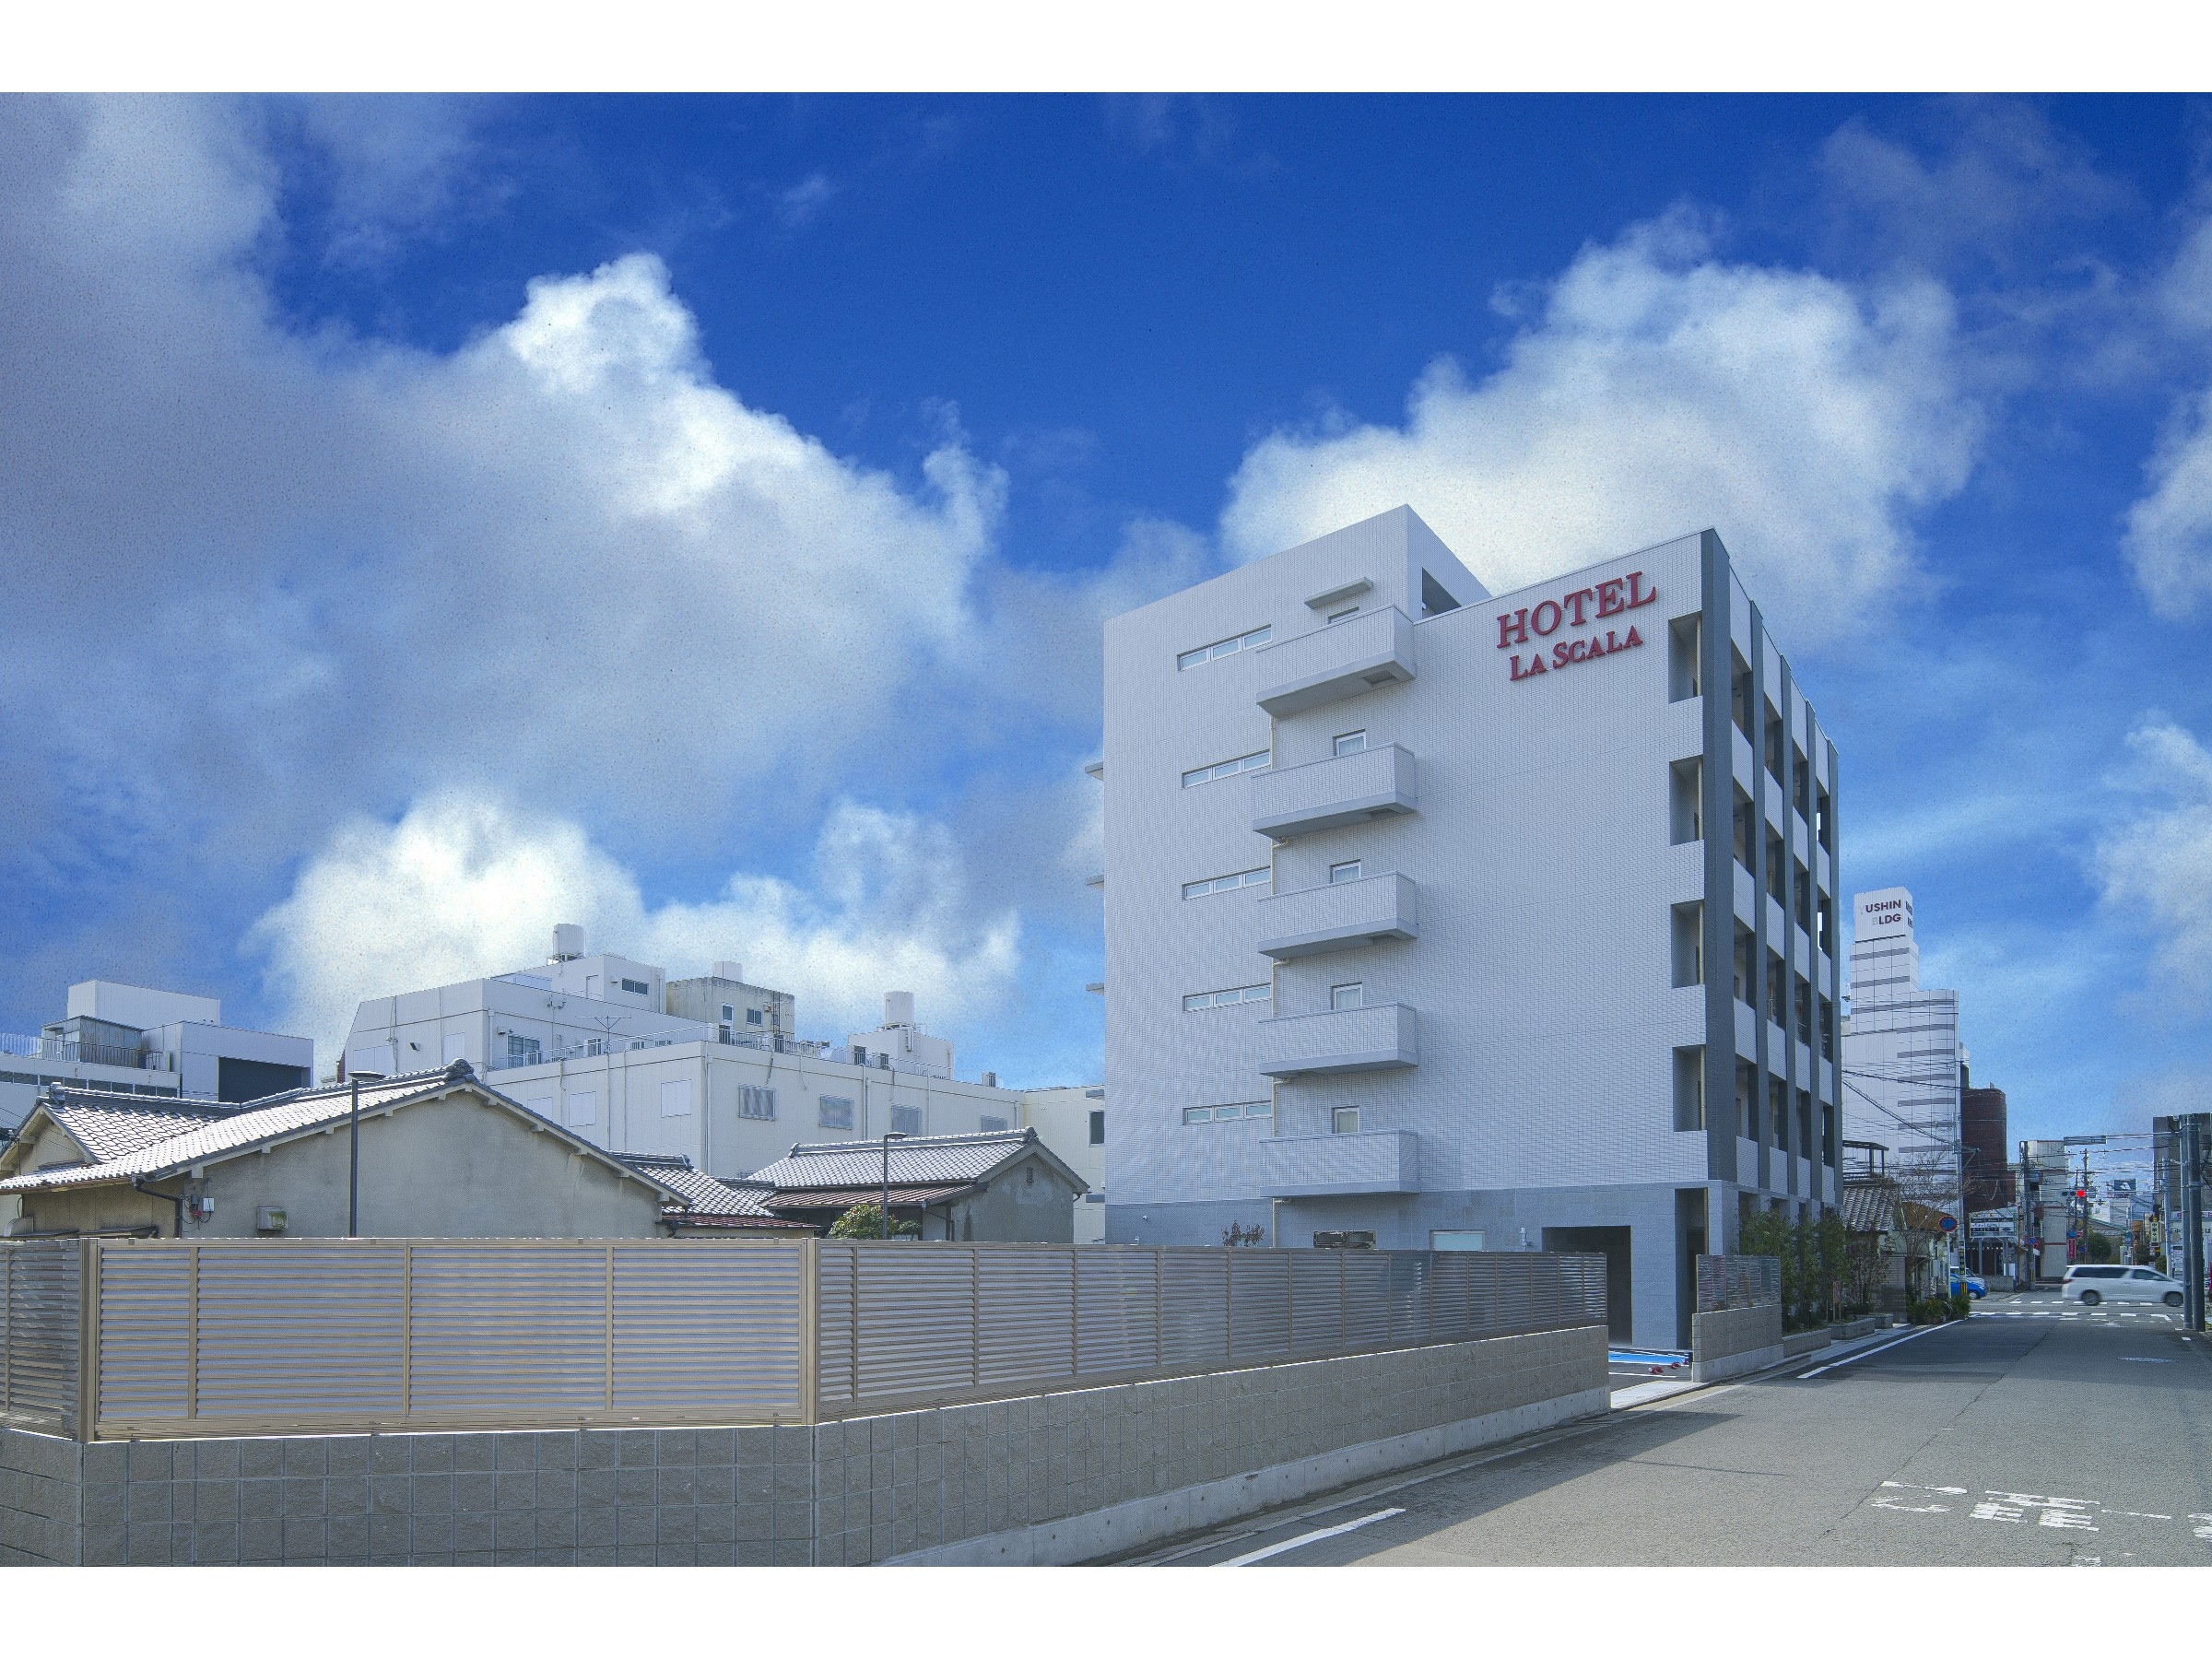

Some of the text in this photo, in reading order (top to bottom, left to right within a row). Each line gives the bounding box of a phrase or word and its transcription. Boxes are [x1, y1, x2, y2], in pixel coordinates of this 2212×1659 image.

[1497, 571, 1656, 648] HOTEL
[1510, 625, 1643, 681] LA SCALA
